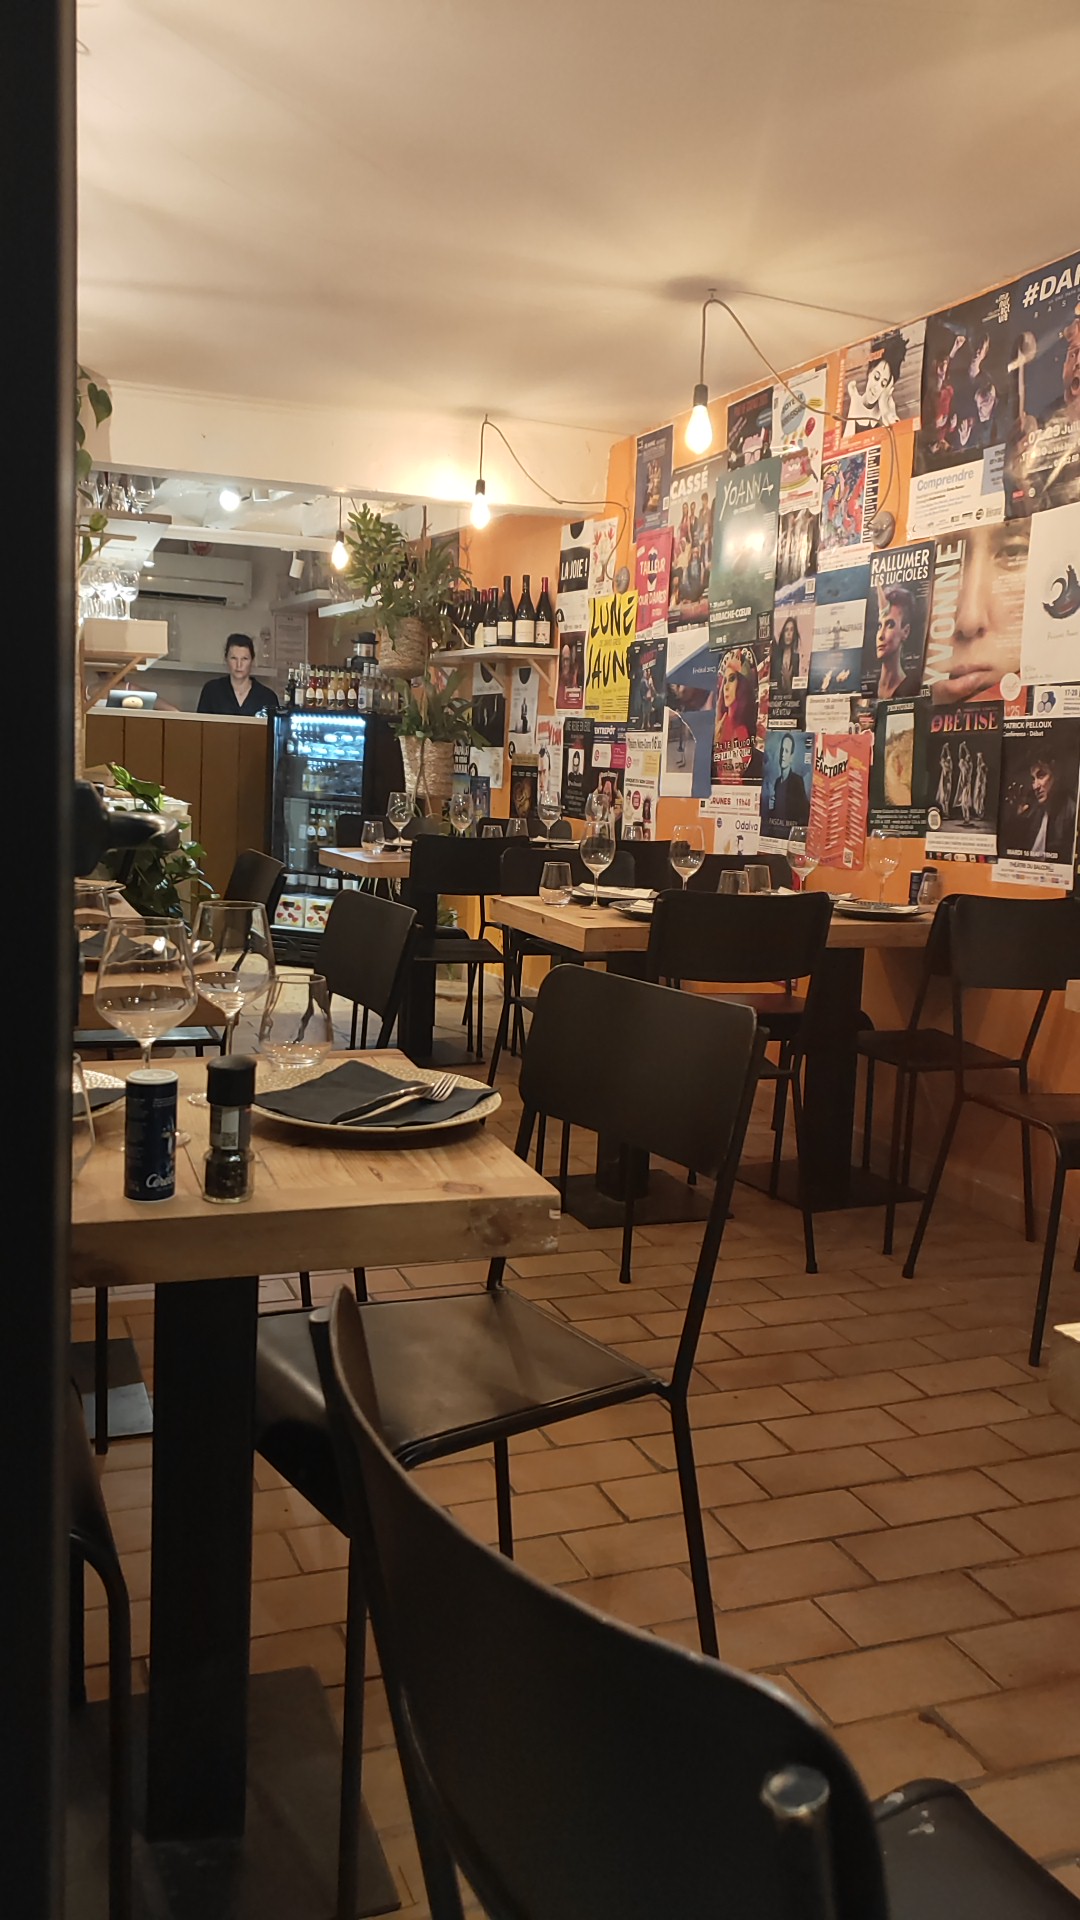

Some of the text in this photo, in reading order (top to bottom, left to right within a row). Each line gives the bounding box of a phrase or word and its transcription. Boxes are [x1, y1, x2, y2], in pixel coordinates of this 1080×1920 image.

[670, 466, 709, 500] CASSÉ
[917, 468, 974, 491] Comprendre
[719, 472, 774, 521] YOANNA
[561, 561, 569, 580] LA
[569, 558, 584, 579] JOIE
[640, 557, 666, 576] TAILLEUR
[871, 549, 930, 575] RALLUMER
[885, 565, 929, 585] LUCIOLES
[638, 594, 649, 606] OUR
[590, 593, 635, 639] LUNE
[922, 540, 963, 687] YVONNE
[1025, 721, 1053, 729] PELLOUX
[815, 759, 849, 779] FACTORY
